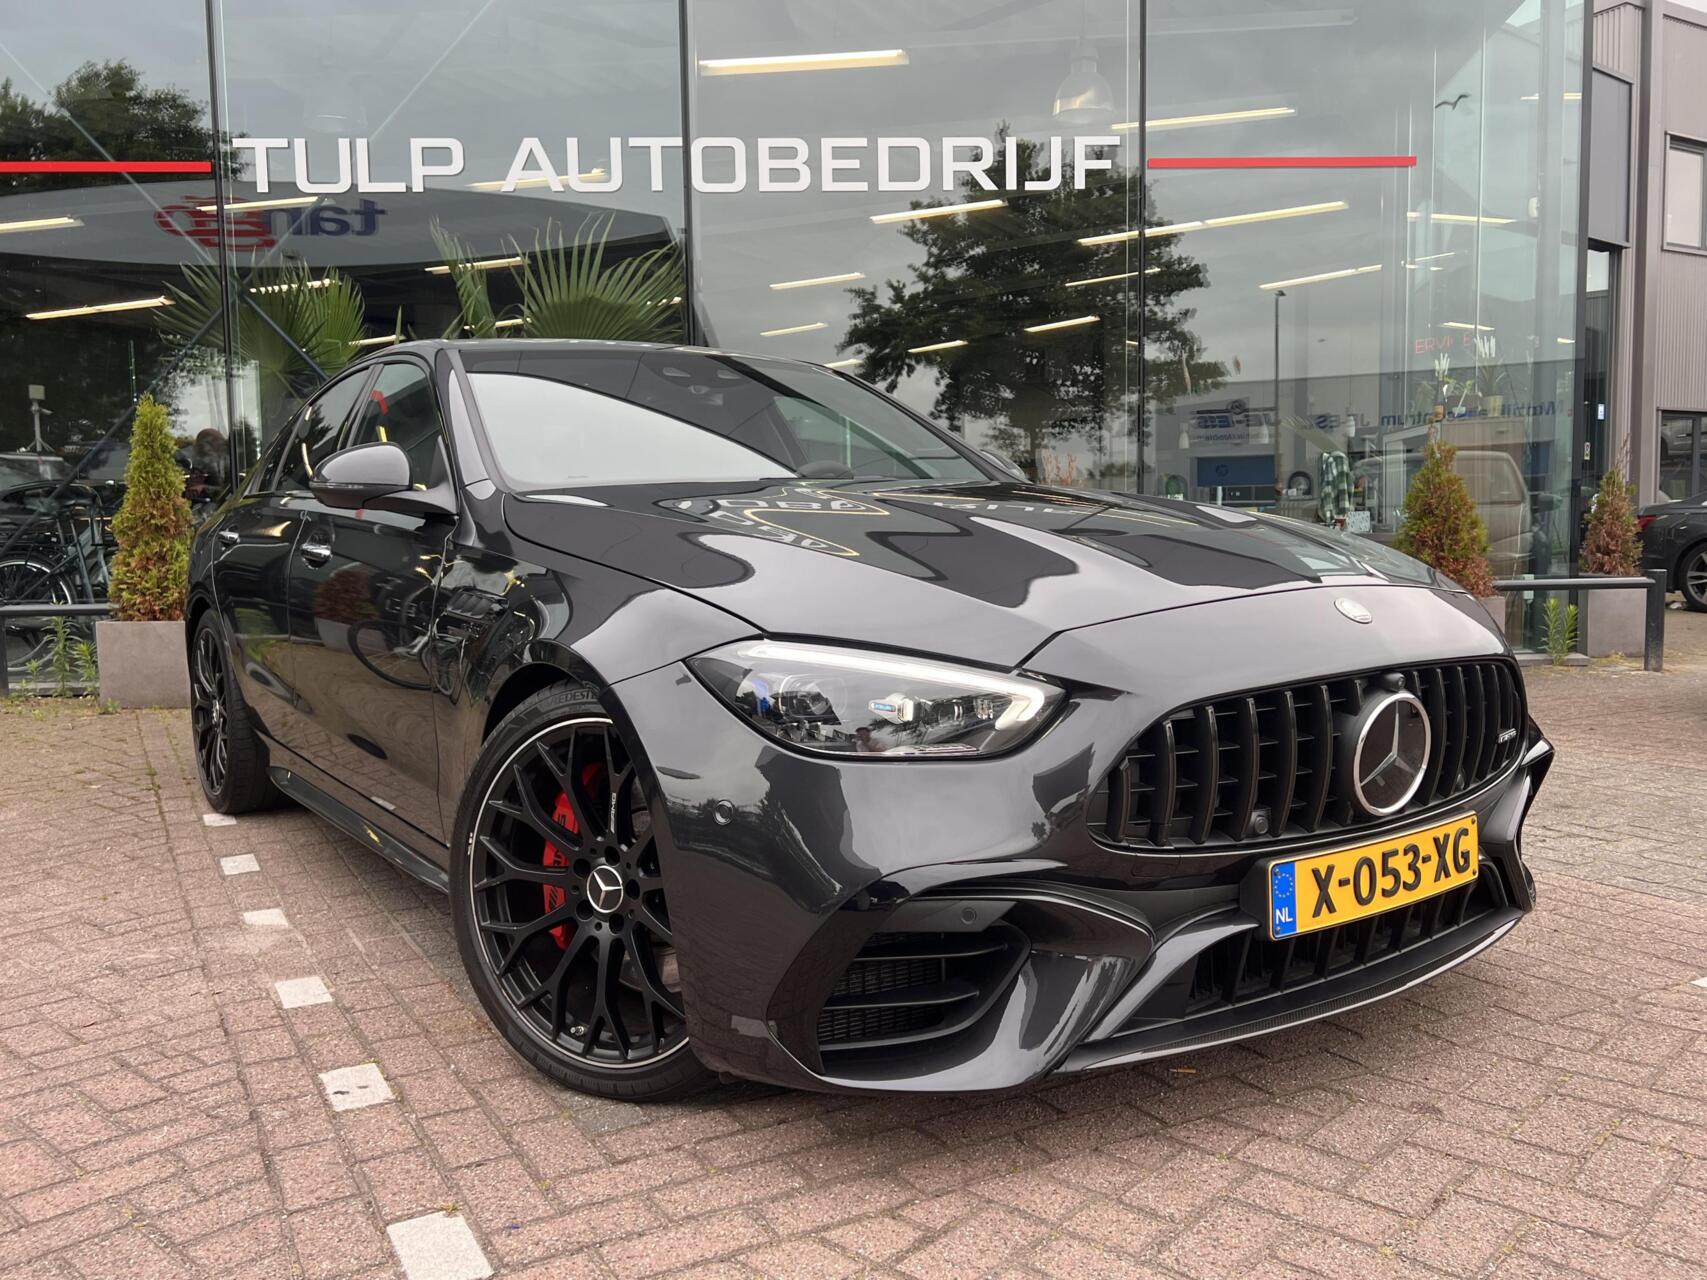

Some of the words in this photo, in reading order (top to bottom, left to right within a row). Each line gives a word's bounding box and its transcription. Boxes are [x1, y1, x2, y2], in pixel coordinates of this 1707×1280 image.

[231, 137, 466, 194] TULP
[501, 135, 1121, 193] AUTOBEDRIJF
[1311, 827, 1471, 918] X-053-XG
[1275, 907, 1293, 925] NL
